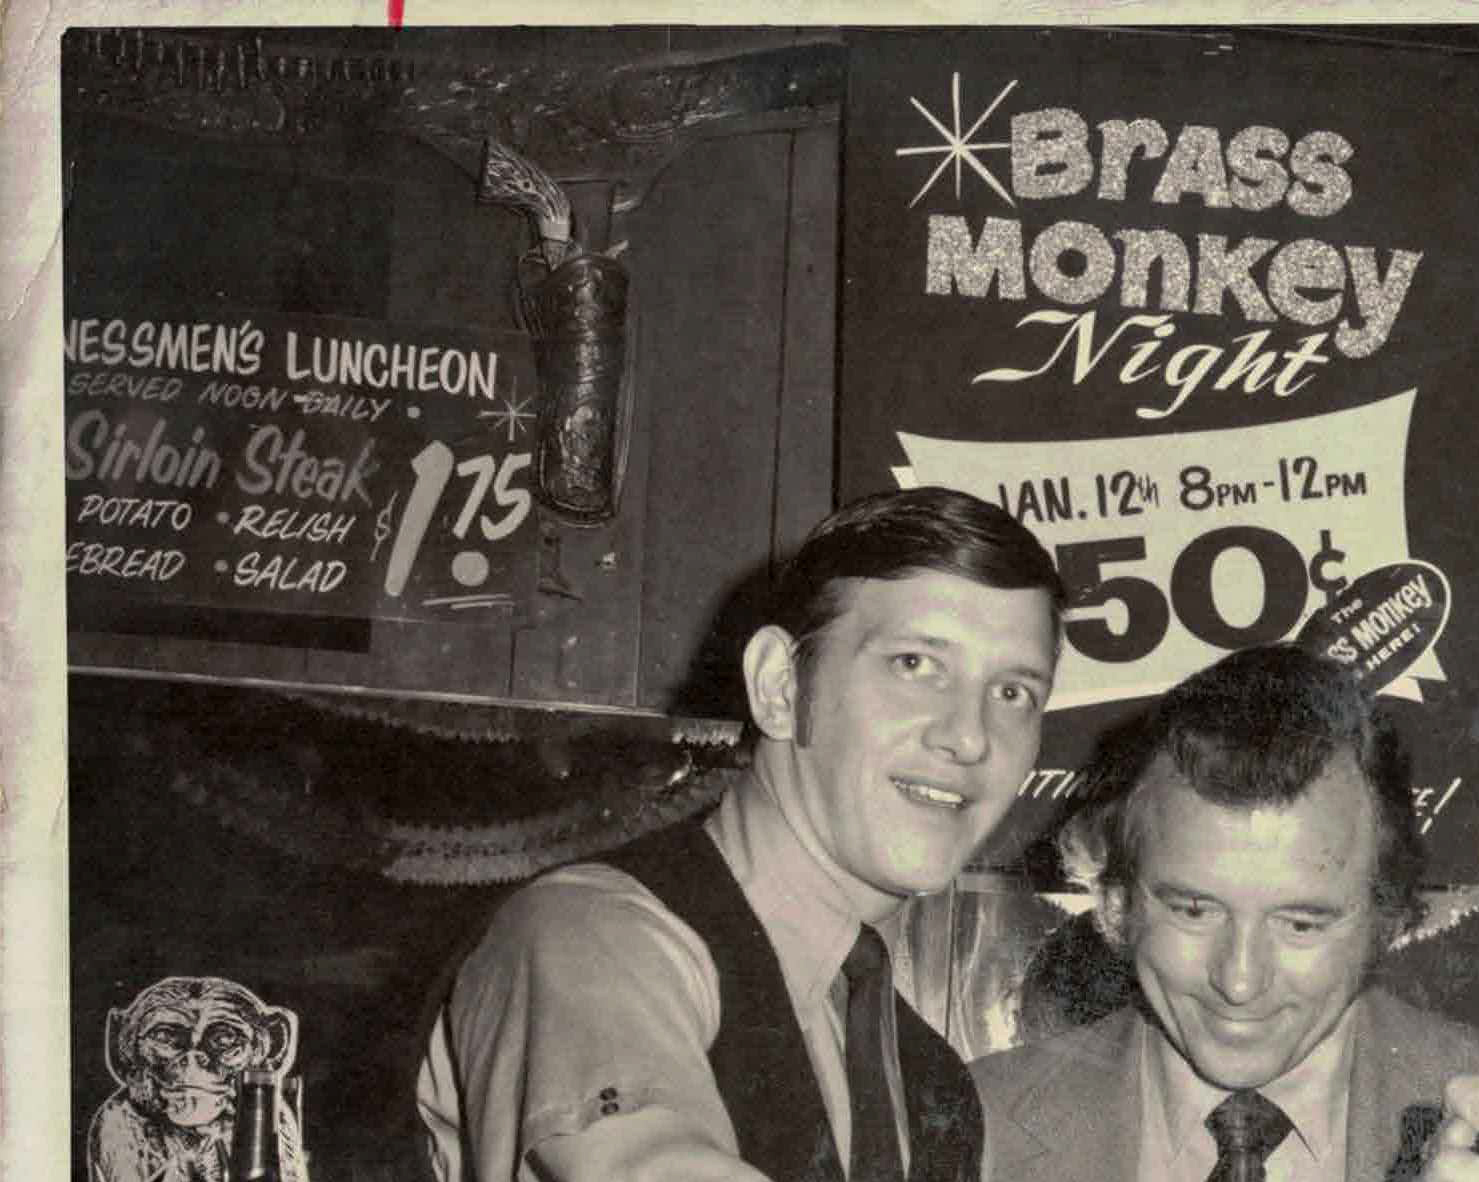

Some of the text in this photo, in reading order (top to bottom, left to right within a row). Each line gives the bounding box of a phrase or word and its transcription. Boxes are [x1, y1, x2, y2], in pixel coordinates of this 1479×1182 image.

[67, 373, 184, 401] SERVED
[199, 380, 288, 412] NOON
[286, 331, 498, 400] LUNCHEON
[971, 310, 1330, 420] Night
[65, 411, 381, 506] Sirloin Steak
[77, 494, 356, 544] POTATO RELISH
[233, 551, 348, 593] SALAD
